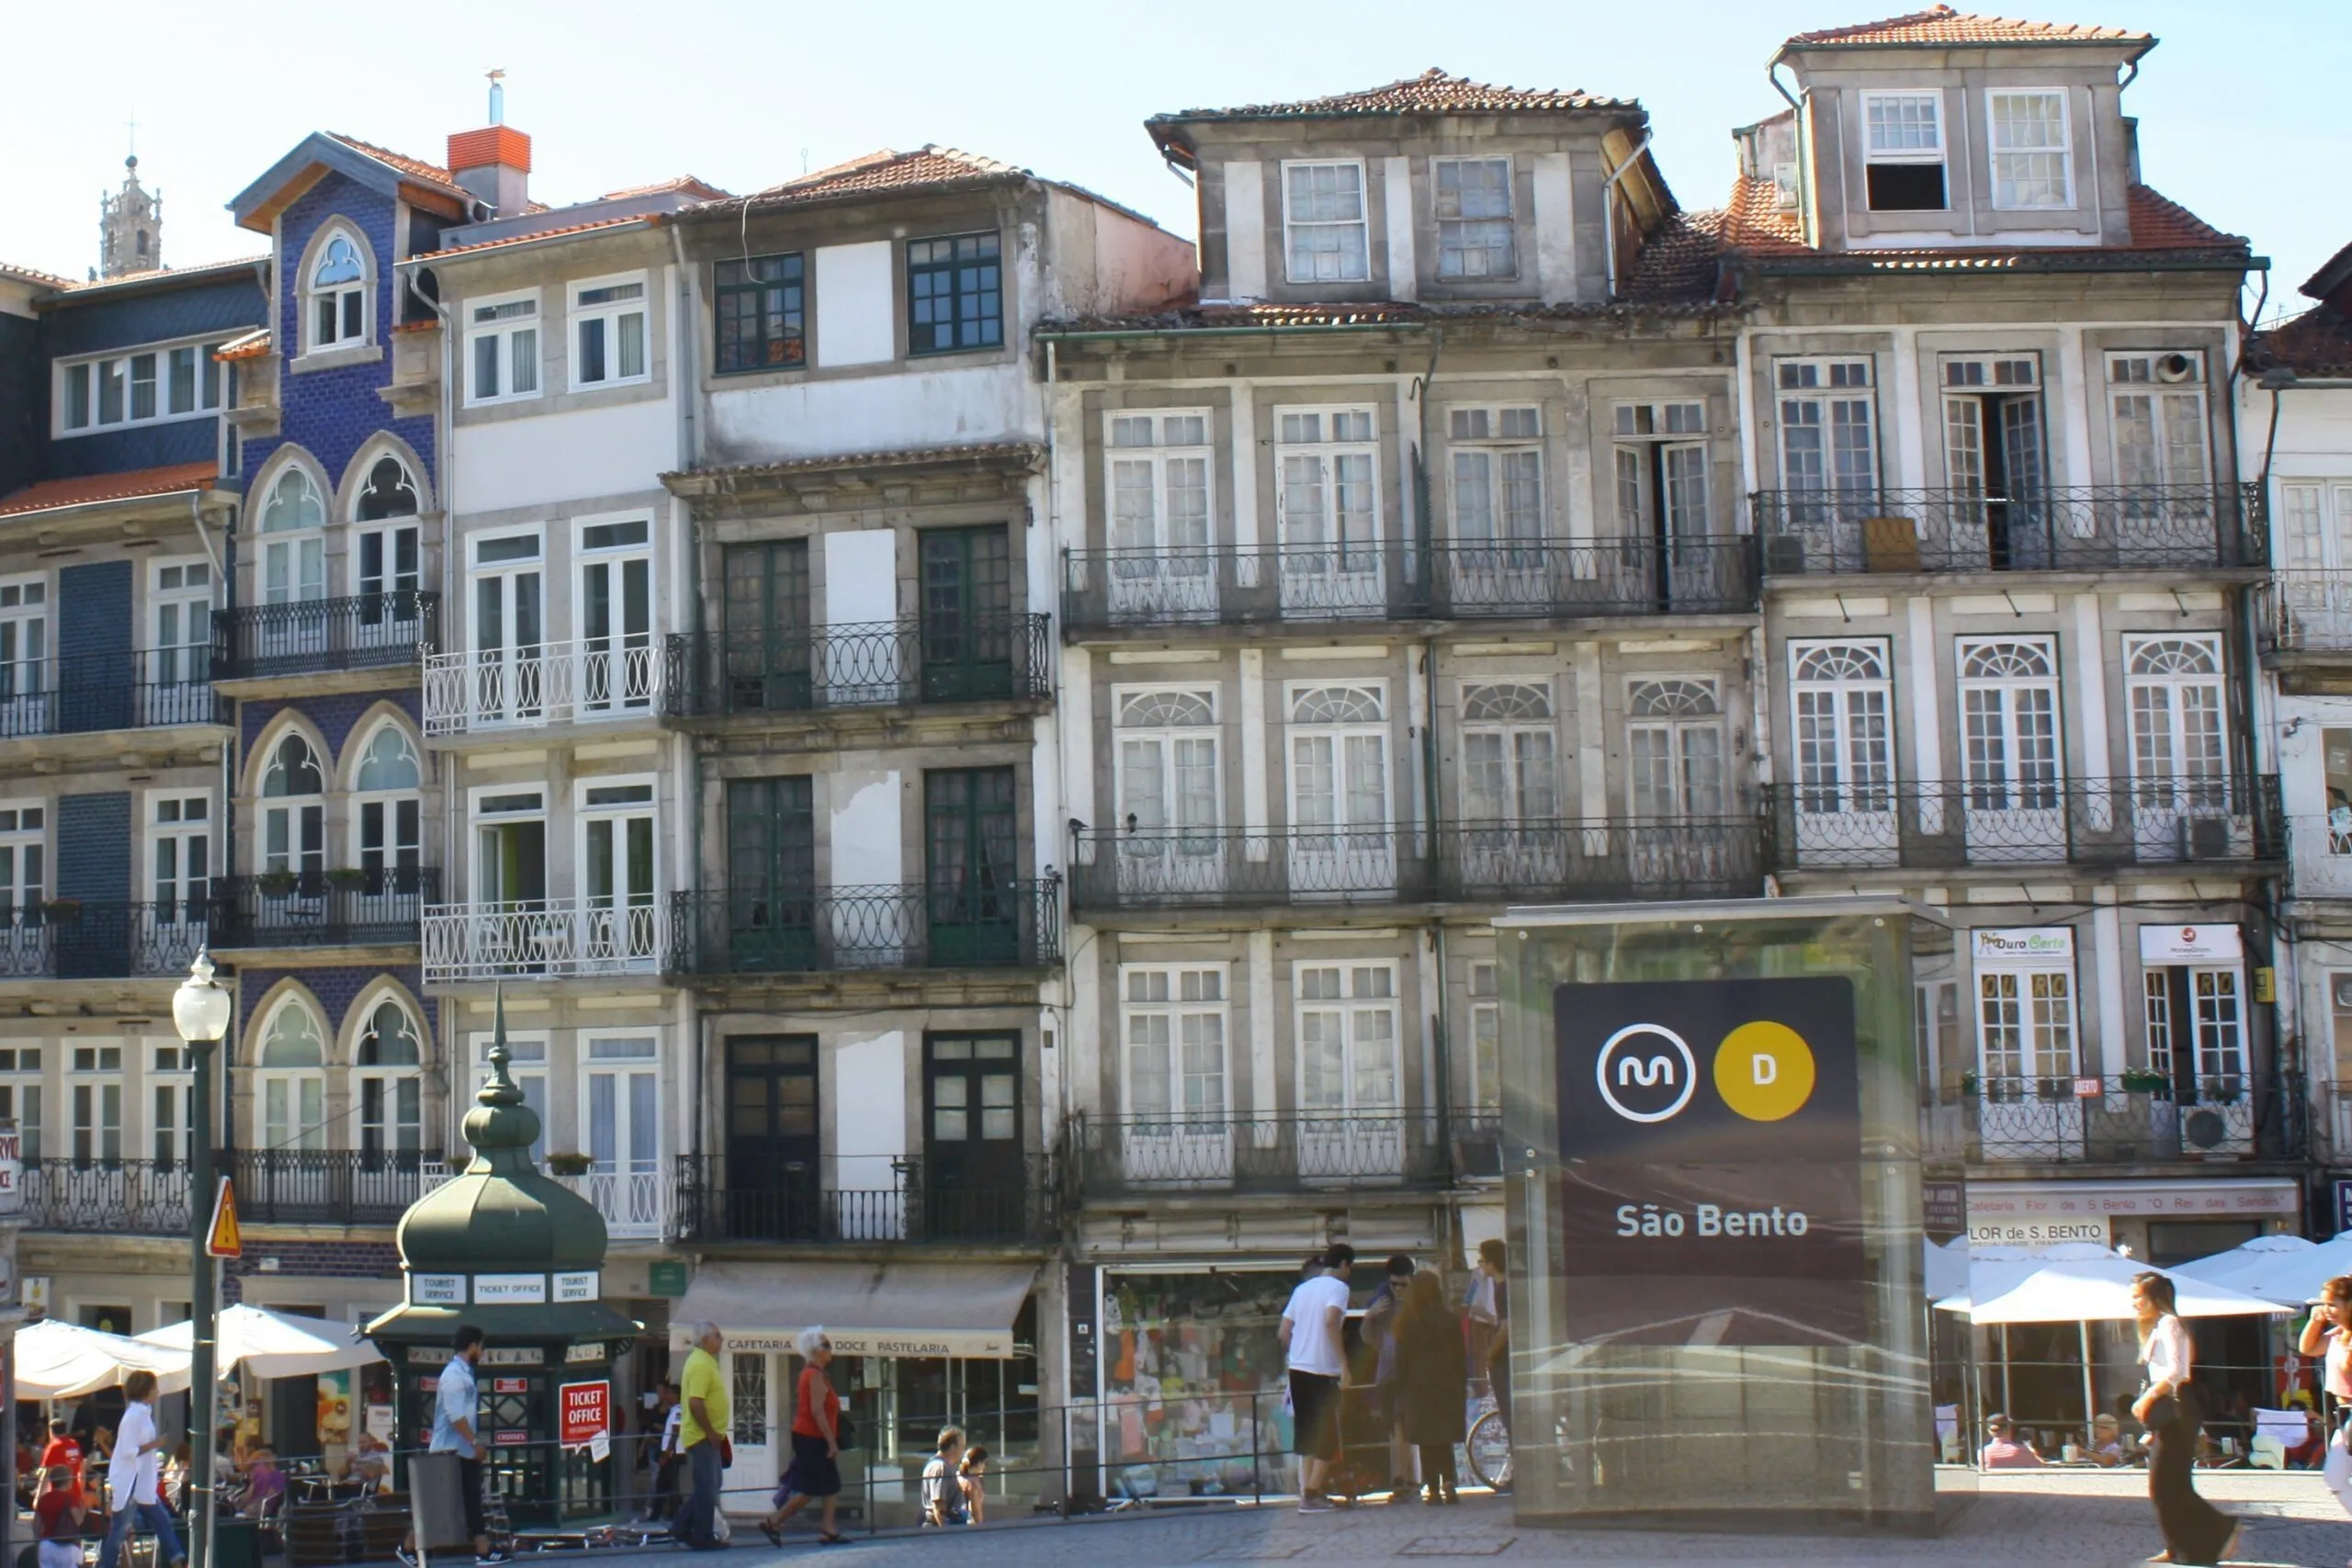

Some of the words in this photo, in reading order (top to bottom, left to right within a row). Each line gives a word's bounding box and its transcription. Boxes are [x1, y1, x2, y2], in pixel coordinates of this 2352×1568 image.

[1997, 938, 2027, 949] Ouro
[2029, 933, 2065, 950] Certo
[1752, 1054, 1778, 1085] D
[2026, 1200, 2048, 1211] Flor
[2061, 1200, 2075, 1211] de
[2103, 1199, 2136, 1210] Bento
[2174, 1197, 2194, 1208] Rei
[2205, 1197, 2225, 1208] das
[1616, 1203, 1685, 1237] São
[1697, 1204, 1809, 1237] Bento
[1968, 1226, 2002, 1240] LOR
[2006, 1225, 2025, 1240] de
[424, 1278, 456, 1288] TOURIST
[560, 1276, 588, 1286] TOURIST
[424, 1290, 455, 1301] SERVICE
[479, 1285, 510, 1294] TICKET
[512, 1284, 541, 1293] OFFICE
[561, 1288, 587, 1298] SERVICE
[727, 1338, 793, 1350] CAFETARIA
[834, 1340, 867, 1352] DOCE
[876, 1341, 950, 1354] PASTELARIA
[569, 1390, 602, 1407] TICKET
[568, 1407, 602, 1425] OFFICE
[497, 1432, 526, 1441] CRUISES
